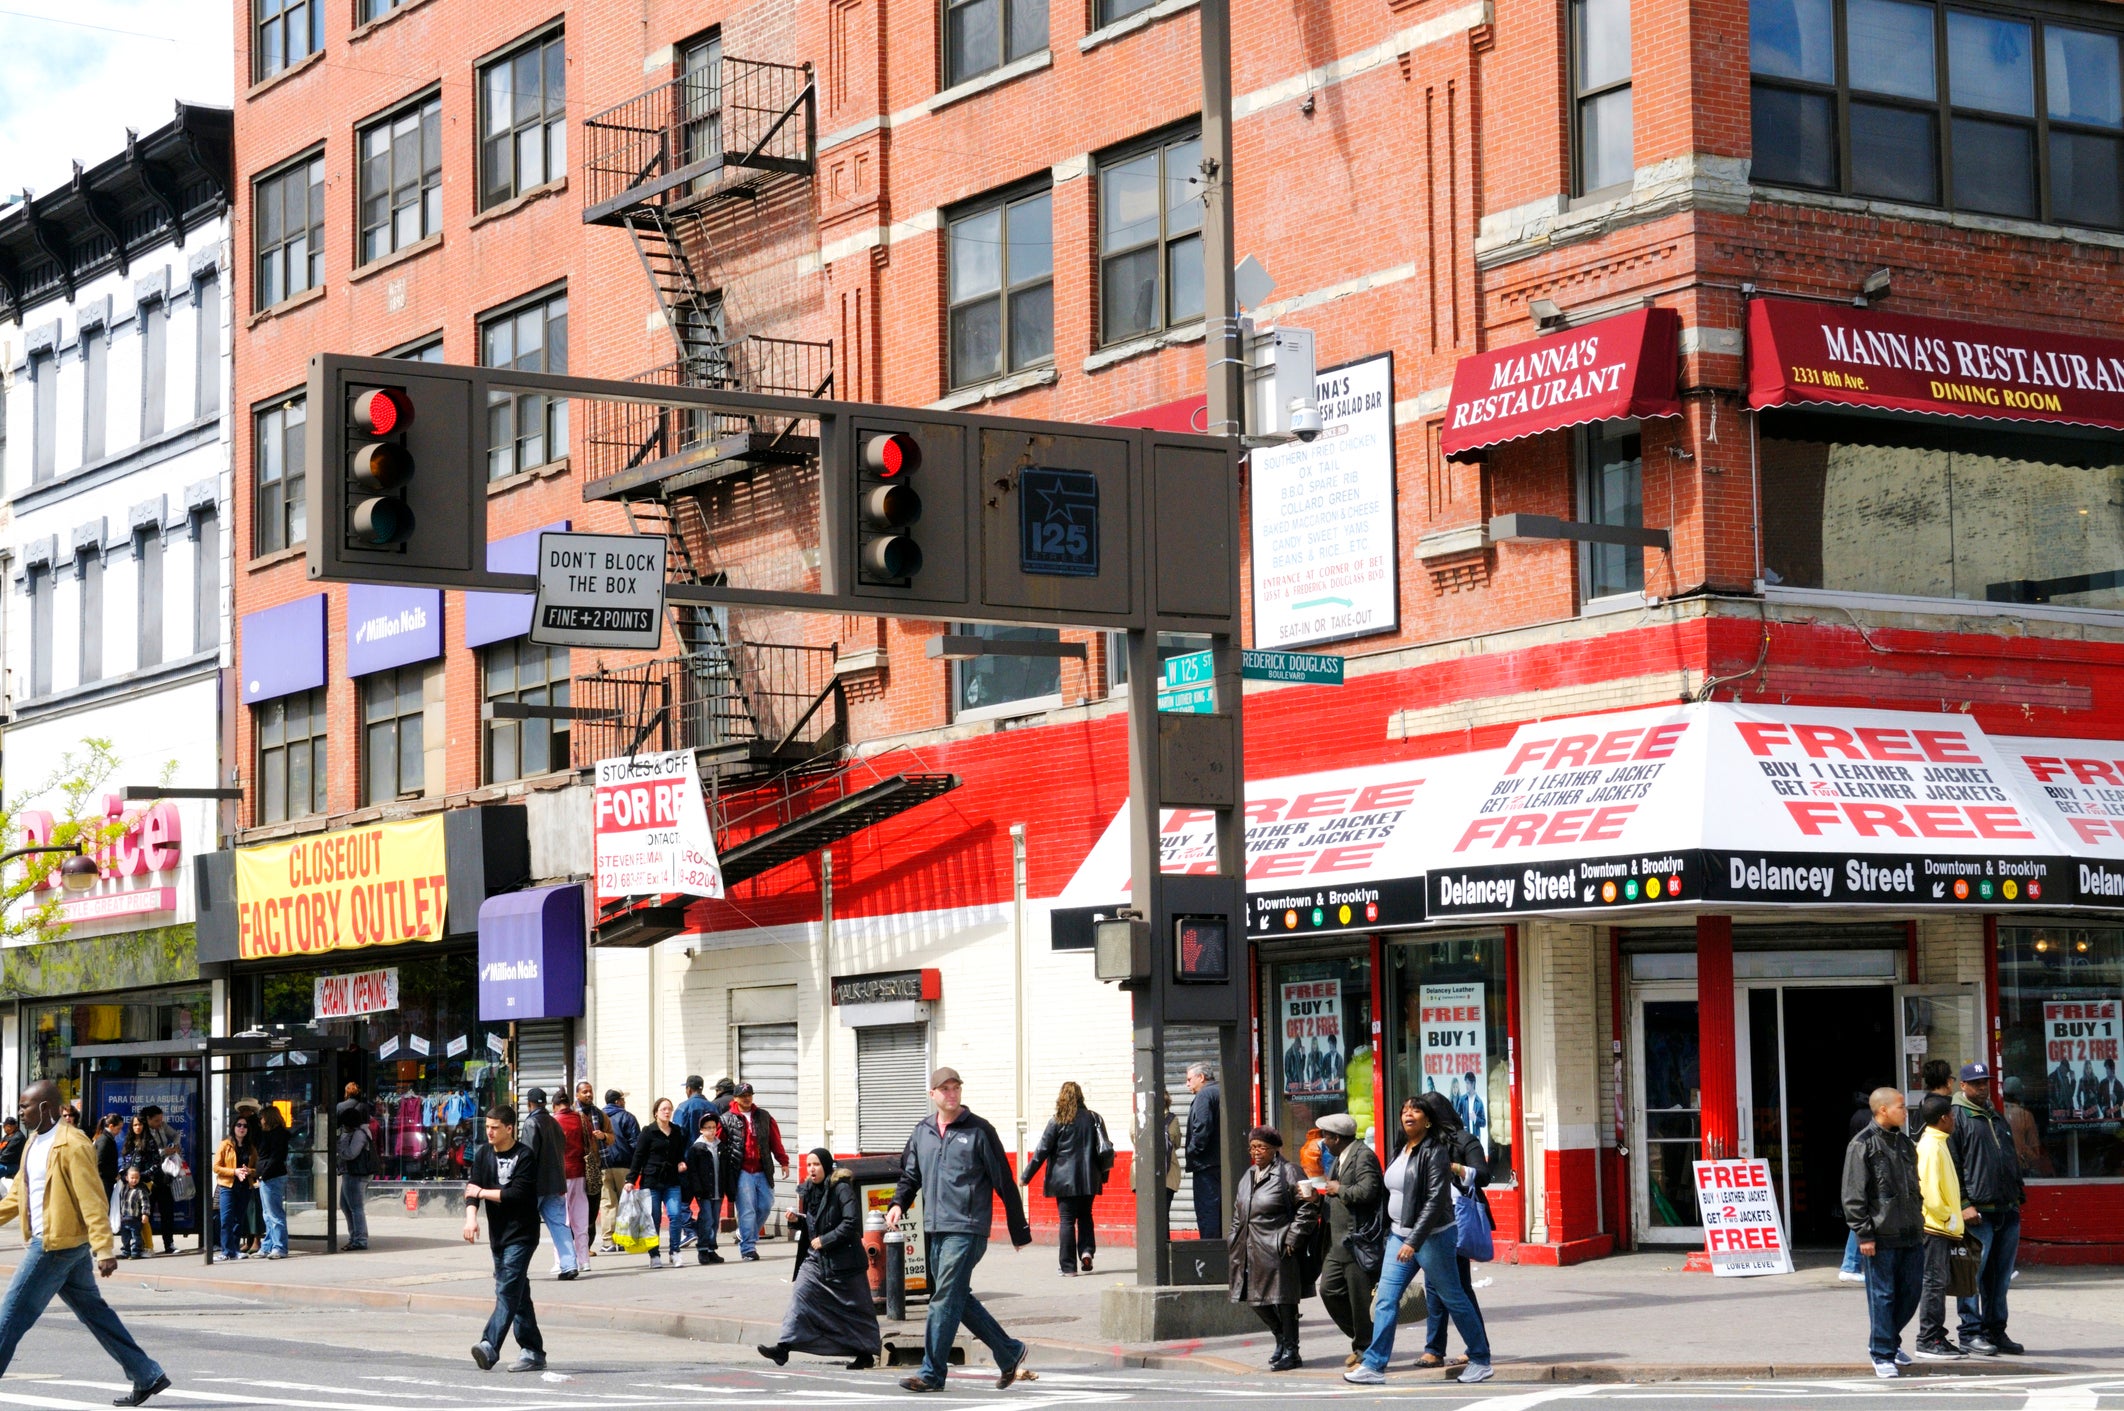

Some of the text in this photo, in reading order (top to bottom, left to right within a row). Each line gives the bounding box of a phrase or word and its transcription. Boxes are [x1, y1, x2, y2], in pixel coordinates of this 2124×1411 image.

[1821, 324, 1950, 375] MANNA'S
[1489, 337, 1598, 390] MANNA'S
[1792, 367, 1869, 390] 2331 8th Ave.
[1337, 391, 1382, 418] SALAD BAR
[1452, 363, 1626, 429] RESTAURANT
[1930, 381, 2062, 412] DINING ROOM
[1264, 452, 1308, 470] SOUTHERN
[1312, 443, 1334, 459] FRIED
[1340, 434, 1376, 452] CHICKEN
[1299, 460, 1340, 479] OX TAIL
[1309, 476, 1338, 493] SPARE
[1344, 470, 1358, 484] RIB
[1281, 488, 1360, 516] COLLARD GREEN
[1264, 520, 1289, 537] BAKED
[1348, 501, 1380, 518] CHEESE
[1032, 522, 1088, 556] 125
[1308, 528, 1338, 545] SWEET
[1344, 520, 1369, 536] YAMS
[550, 551, 655, 571] DON'T BLOCK
[1273, 552, 1303, 568] BEANS
[569, 576, 636, 594] THE BOX
[1263, 572, 1300, 589] ENTRANCE
[1306, 570, 1315, 580] AT
[1319, 562, 1349, 578] CORNER
[1354, 560, 1364, 571] OF
[1294, 580, 1327, 596] FREDERICK
[1330, 572, 1364, 589] DOUGLASS
[366, 616, 400, 642] Million
[400, 606, 426, 633] Nails
[549, 609, 578, 626] FINE
[604, 611, 648, 629] POINTS
[1280, 609, 1372, 639] SEAT-IN OR TAKE-OUT
[1168, 655, 1212, 684] W 125 ST
[1268, 670, 1306, 680] BOULEVARD
[1289, 656, 1338, 673] DOUGLASS
[1504, 722, 1690, 775] FREE
[1734, 722, 1984, 764] FREE
[1492, 763, 1666, 795] BUY 1 LEATHER JACKET
[1758, 761, 1994, 784] BUY 1 LEATHER JACKET
[1480, 782, 1652, 814] GET LEATHER JACKETS
[1771, 780, 1809, 796] GET
[1835, 783, 1917, 800] LEATHER
[2044, 786, 2078, 799] BUY
[2083, 789, 2094, 800] 1
[597, 788, 648, 828] FOR
[2055, 800, 2085, 814] GET
[1319, 810, 1406, 832] JACKET
[1452, 804, 1639, 853] FREE
[1784, 801, 2036, 839] FREE
[1298, 825, 1395, 847] JACKETS
[289, 830, 382, 888] CLOSEOUT
[1581, 856, 1684, 879] Downtown Brooklyn
[1925, 859, 2047, 880] Downtown Brooklyn
[1441, 869, 1576, 908] Delancey Street
[1670, 880, 1680, 891] BK
[1730, 857, 1915, 897] Delancey Street
[1257, 888, 1379, 911] Downtown Brooklyn
[2028, 884, 2039, 895] BK
[95, 892, 155, 914] GREAT PRICE
[351, 875, 445, 945] OUTLET
[240, 889, 341, 957] FACTORY
[490, 961, 517, 982] Million
[518, 960, 538, 980] Nails
[322, 970, 388, 1015] GRAND OPENING
[880, 979, 917, 996] SERVICE
[1284, 982, 1337, 1000] FREE
[1290, 999, 1333, 1016] BUY 1
[1422, 1005, 1481, 1022] FREE
[2046, 1004, 2115, 1019] FREE
[1286, 1015, 1339, 1039] GET 2 FREE
[2054, 1022, 2111, 1037] BUY 1
[1428, 1031, 1475, 1047] BUY 1
[2048, 1038, 2118, 1062] GET 2 FREE
[1424, 1052, 1482, 1075] GET 2 FREE
[109, 1095, 185, 1104] PARA QUE LA ABUELA
[171, 1105, 185, 1113] QUE
[1697, 1165, 1767, 1189] FREE
[1702, 1190, 1768, 1204] BUY LEATHER JACKET
[1706, 1212, 1721, 1224] GET
[1722, 1206, 1737, 1217] 2
[1740, 1210, 1772, 1222] JACKETS
[1709, 1227, 1780, 1251] FREE
[1726, 1261, 1775, 1270] LOWER LEVEL
